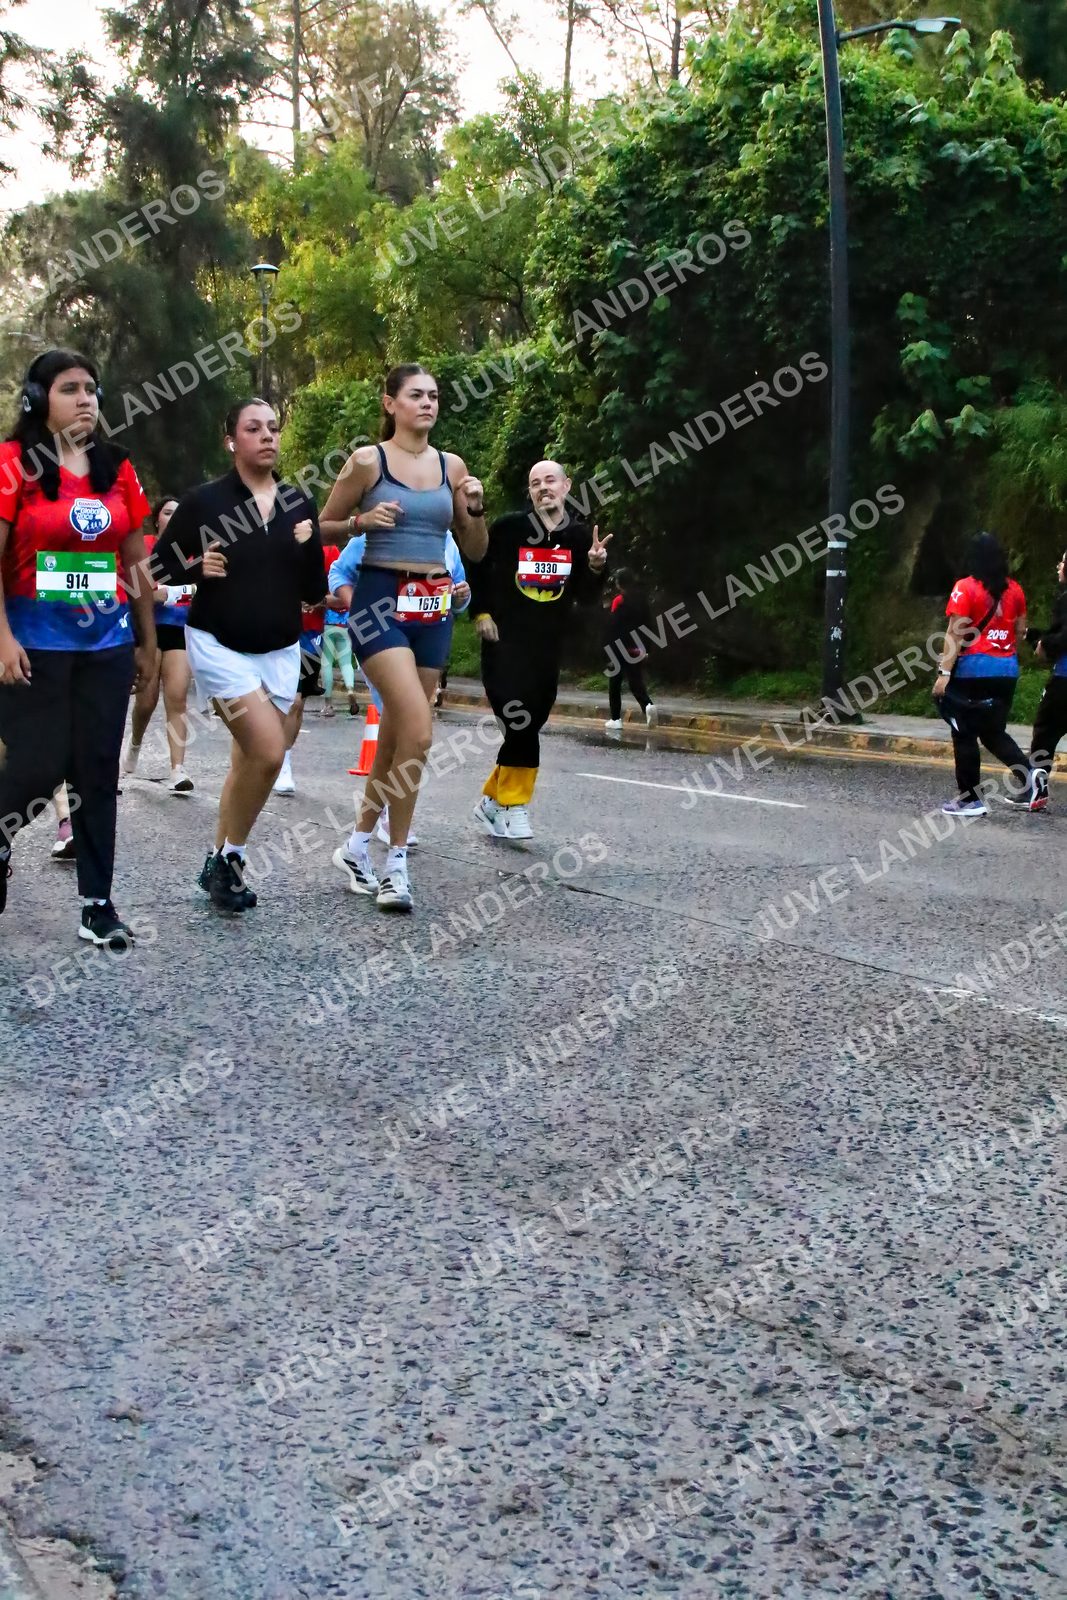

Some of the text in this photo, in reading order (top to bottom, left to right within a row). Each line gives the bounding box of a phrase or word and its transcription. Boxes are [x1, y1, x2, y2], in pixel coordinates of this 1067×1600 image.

[534, 562, 558, 574] 3330
[66, 573, 89, 589] 914
[418, 597, 440, 611] 1675
